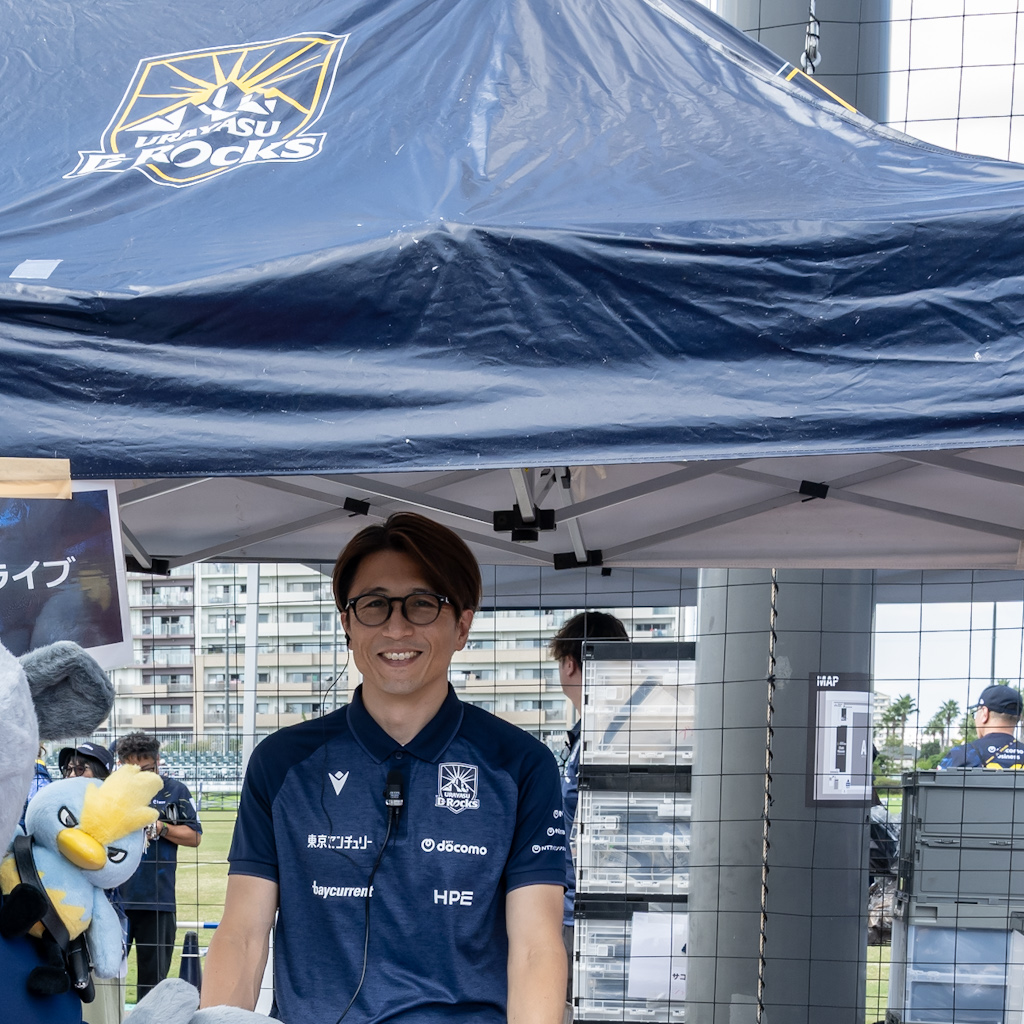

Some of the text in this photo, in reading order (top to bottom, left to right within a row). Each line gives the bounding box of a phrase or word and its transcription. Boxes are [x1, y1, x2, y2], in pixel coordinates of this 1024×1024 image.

[134, 117, 282, 148] URAYASU
[816, 675, 840, 687] MAP
[444, 791, 471, 800] URAYASU
[306, 833, 373, 850] 東京センチュリー
[436, 839, 488, 856] docomo
[312, 880, 375, 899] baycurrent
[433, 889, 474, 906] HPE
